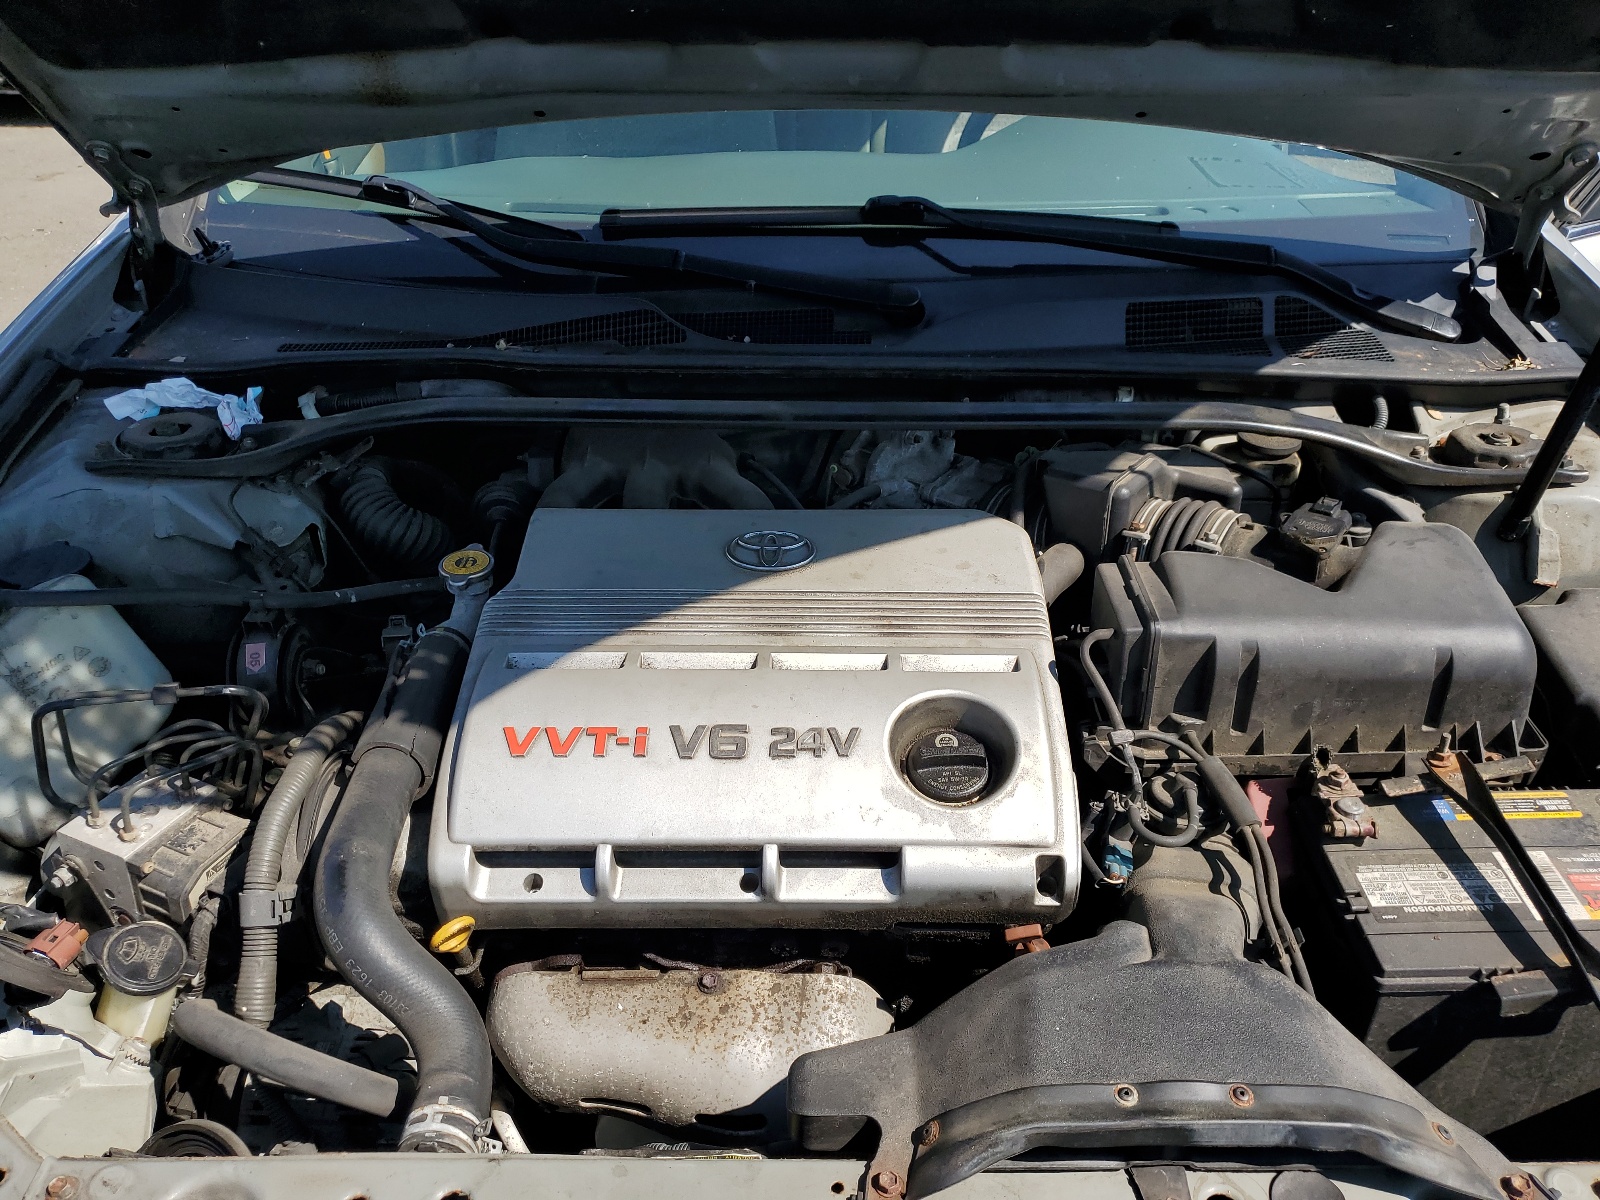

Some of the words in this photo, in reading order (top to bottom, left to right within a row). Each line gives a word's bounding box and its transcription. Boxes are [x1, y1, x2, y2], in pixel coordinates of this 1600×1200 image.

[503, 726, 650, 758] VVT-i
[668, 723, 749, 760] V6
[768, 726, 861, 759] 24V
[324, 926, 344, 954] EBP
[345, 958, 373, 988] 1623
